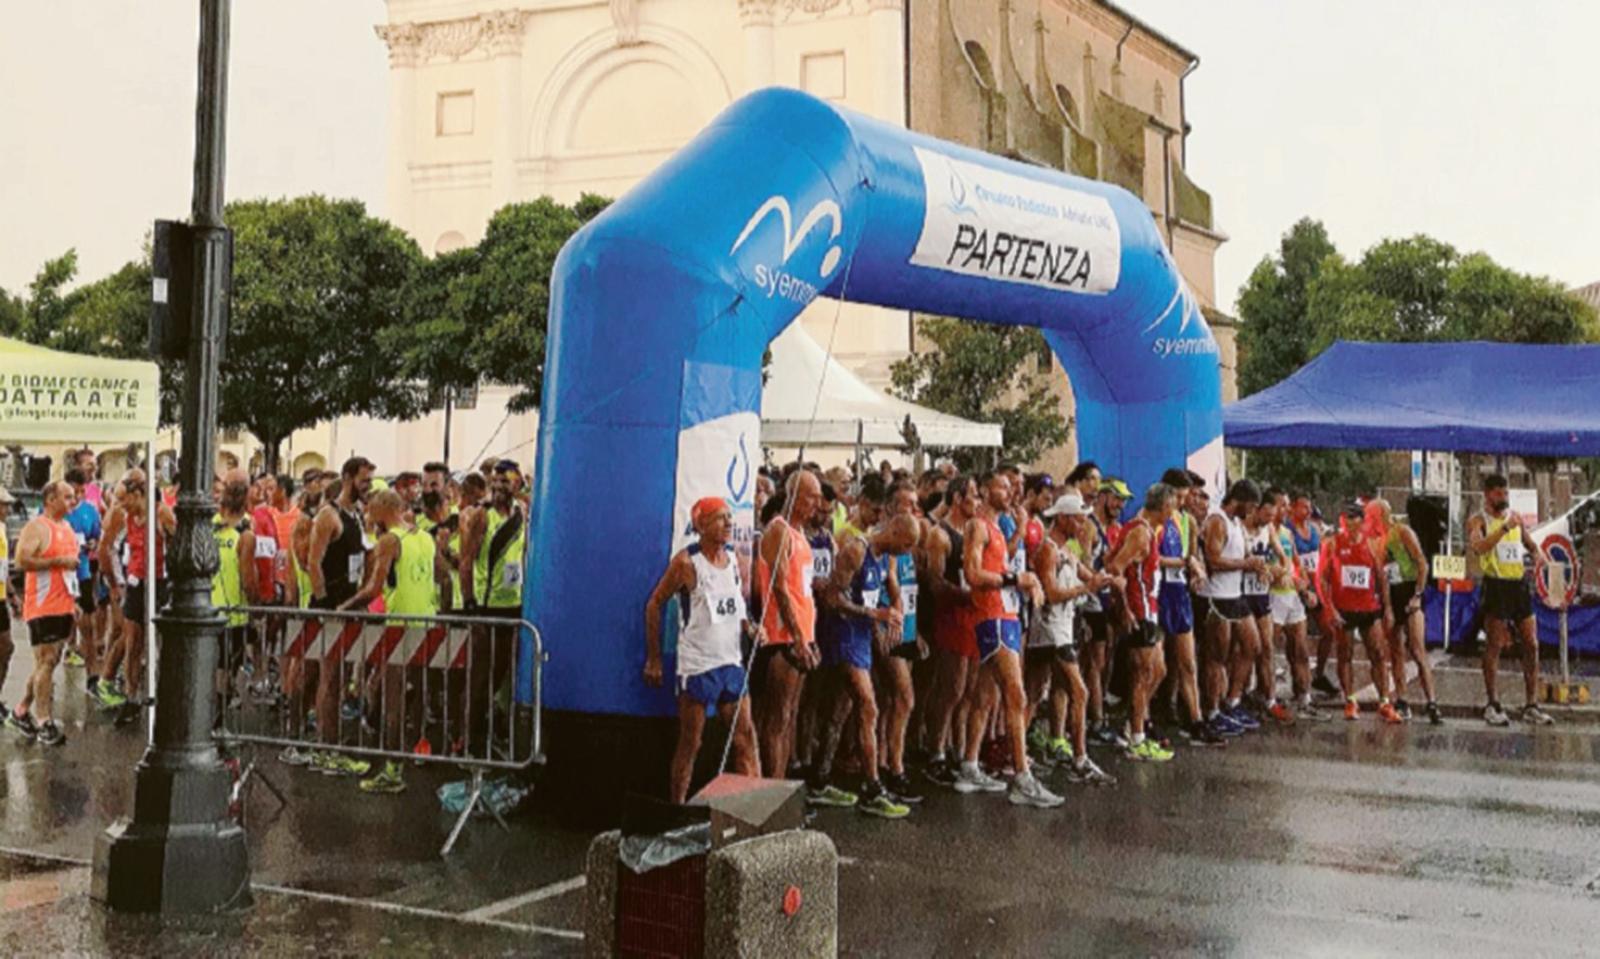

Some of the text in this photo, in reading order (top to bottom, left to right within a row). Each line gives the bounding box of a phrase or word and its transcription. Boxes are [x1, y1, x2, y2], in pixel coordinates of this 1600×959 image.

[946, 223, 1092, 288] PARTENZA
[11, 374, 140, 390] BIOMECCANICA
[88, 391, 102, 407] A
[113, 391, 138, 408] TE
[715, 597, 737, 616] 48
